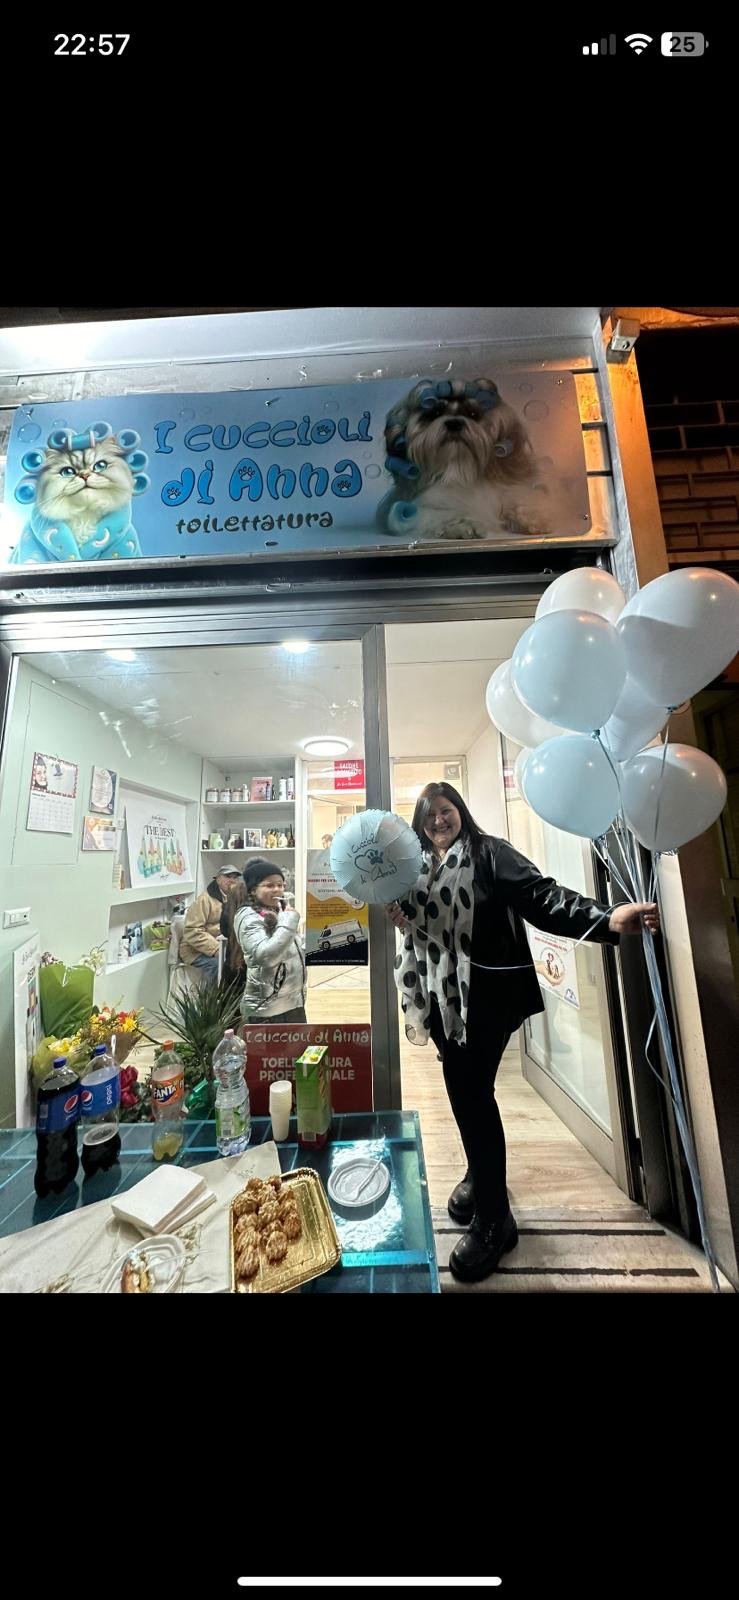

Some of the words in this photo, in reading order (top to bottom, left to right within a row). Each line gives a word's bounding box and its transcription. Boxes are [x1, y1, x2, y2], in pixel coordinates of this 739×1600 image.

[153, 421, 177, 454] I
[160, 459, 215, 507] di
[229, 457, 364, 503] Anna
[144, 824, 159, 836] THE
[332, 1028, 370, 1043] Anna
[153, 1084, 177, 1099] FANTA
